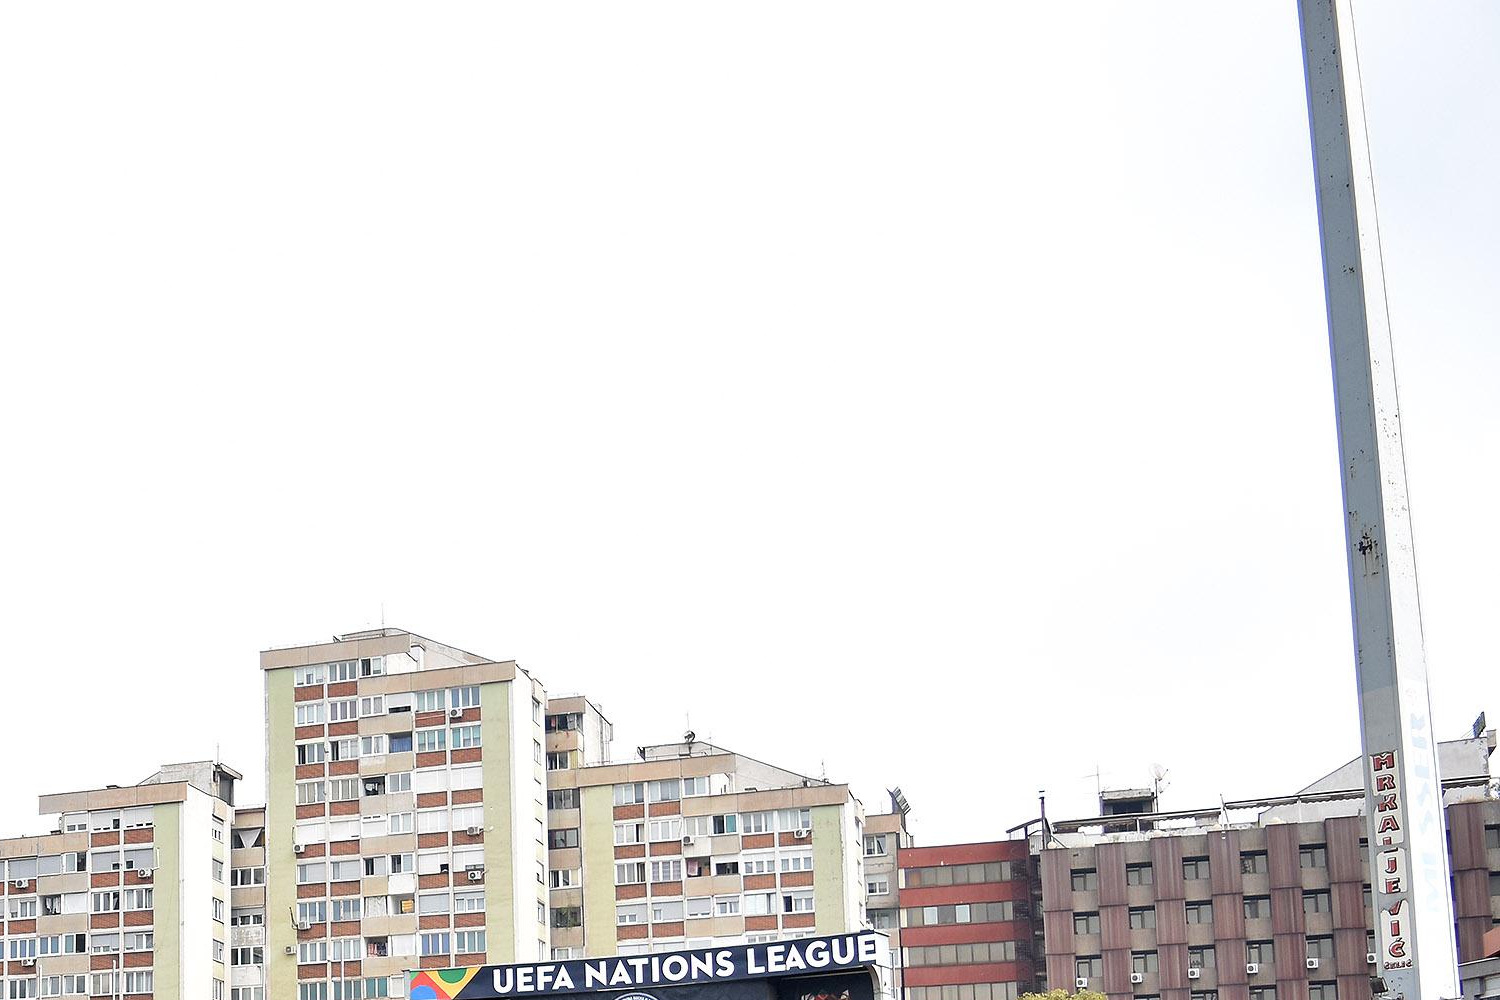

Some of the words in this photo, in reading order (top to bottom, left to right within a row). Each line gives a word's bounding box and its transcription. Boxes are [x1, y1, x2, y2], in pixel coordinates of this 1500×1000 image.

[493, 965, 575, 994] UEFA
[584, 949, 735, 988] NATIONS
[746, 935, 877, 975] LEAGUE
